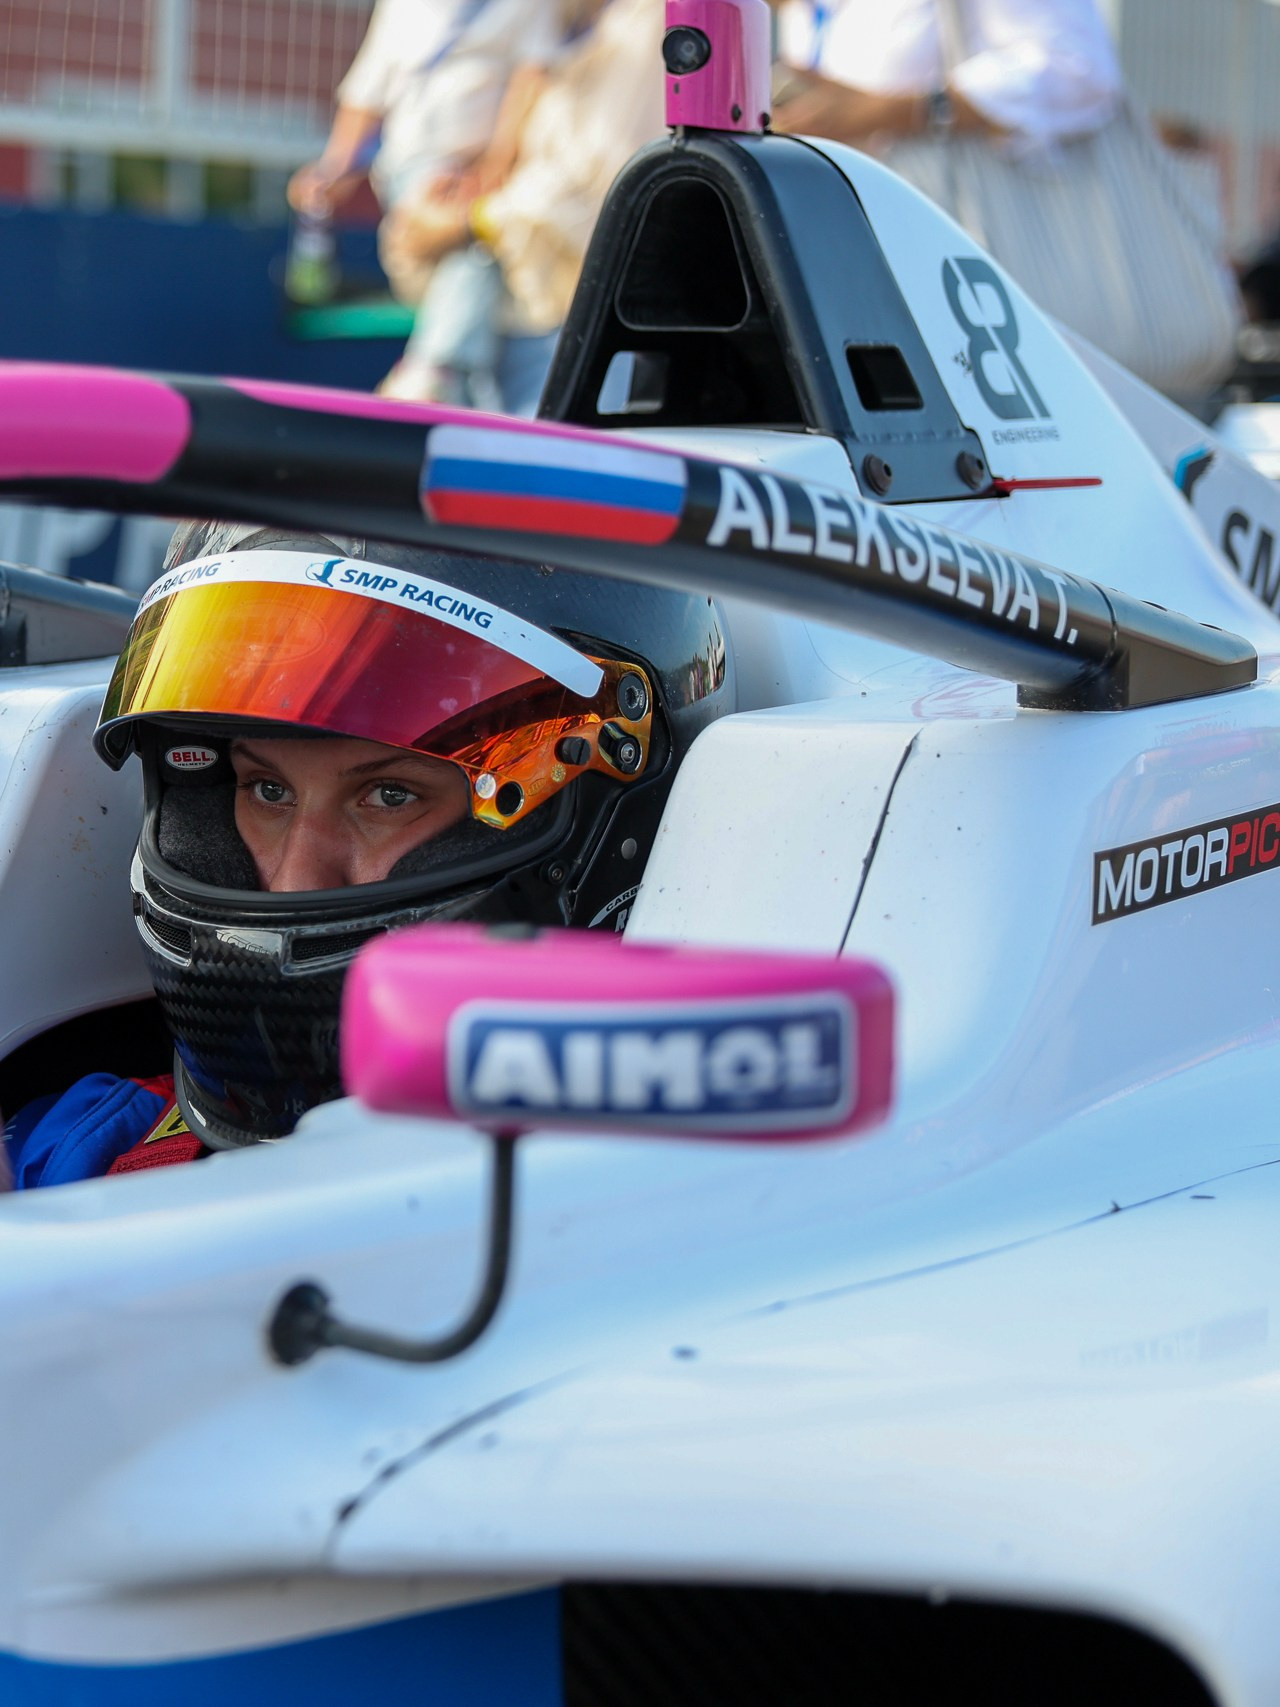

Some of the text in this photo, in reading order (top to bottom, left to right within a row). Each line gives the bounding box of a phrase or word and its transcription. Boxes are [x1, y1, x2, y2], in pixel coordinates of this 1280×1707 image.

[159, 562, 222, 595] RACING
[706, 466, 1078, 645] ALEKSEEVA T.
[340, 569, 494, 629] SMP RACING
[172, 751, 211, 763] BELL
[605, 885, 641, 912] CARB
[471, 1023, 837, 1110] AIMOL
